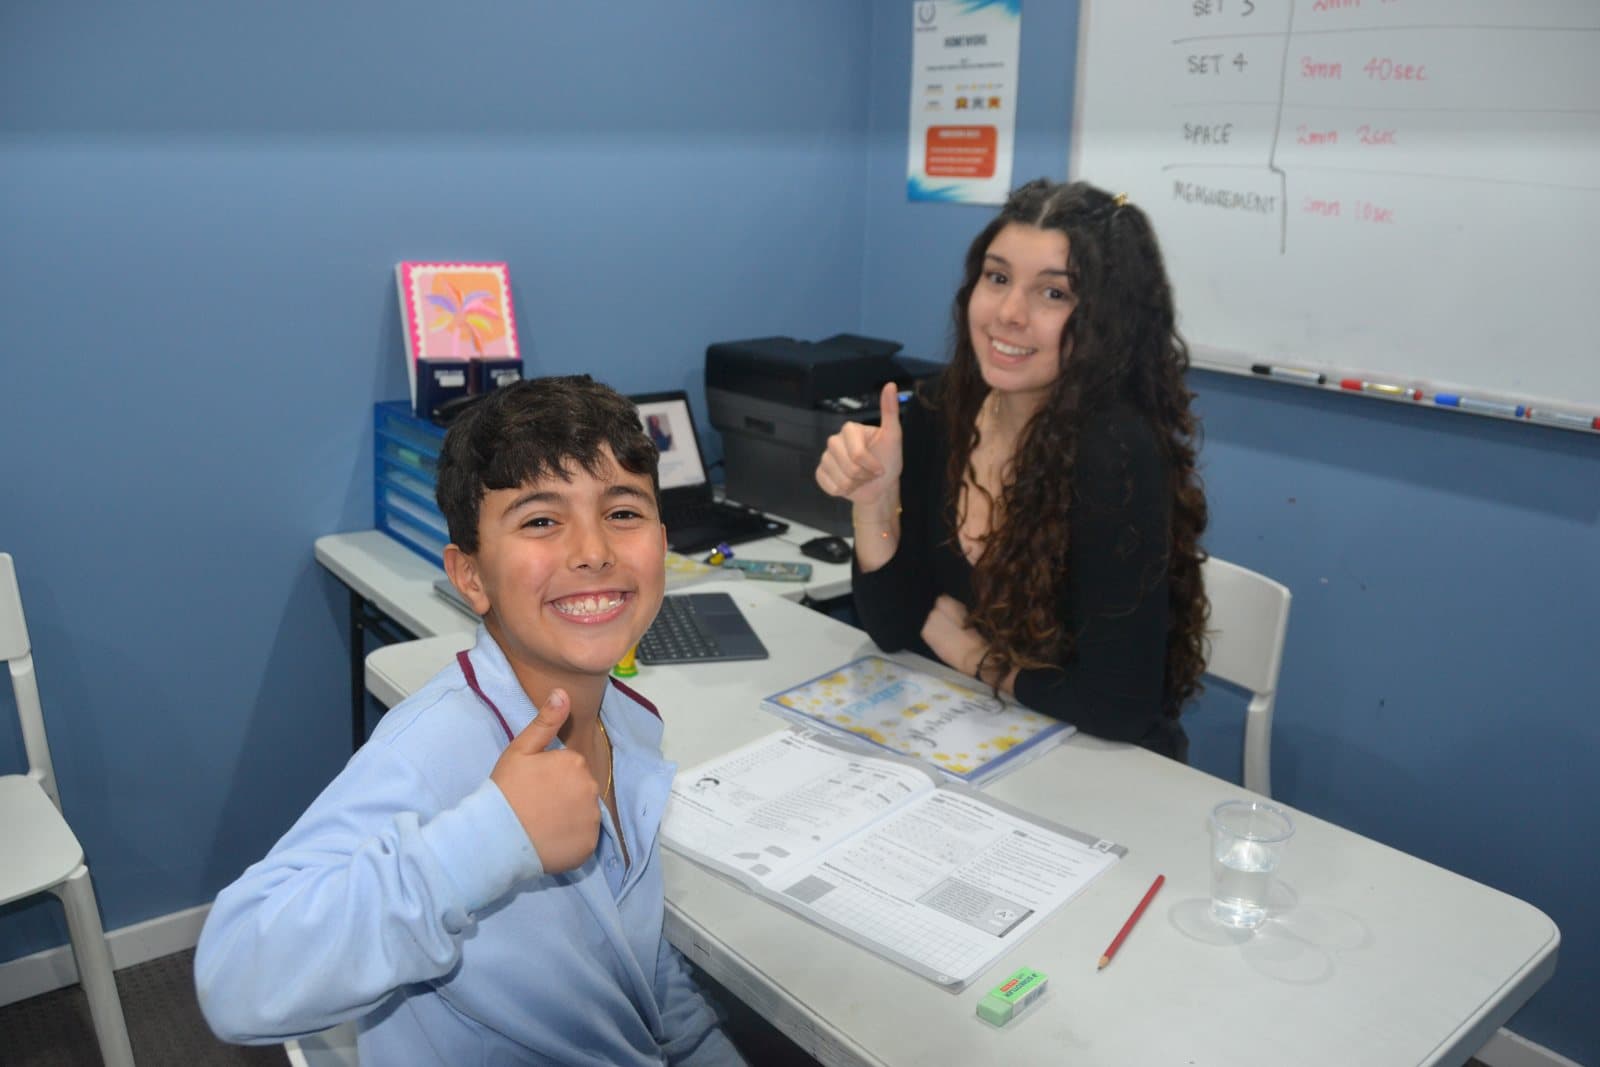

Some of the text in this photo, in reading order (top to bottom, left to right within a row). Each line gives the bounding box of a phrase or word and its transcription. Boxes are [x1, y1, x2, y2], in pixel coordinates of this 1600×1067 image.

[1187, 52, 1248, 74] SET 4
[1362, 57, 1429, 81] 40sec
[1183, 122, 1232, 145] SPACE
